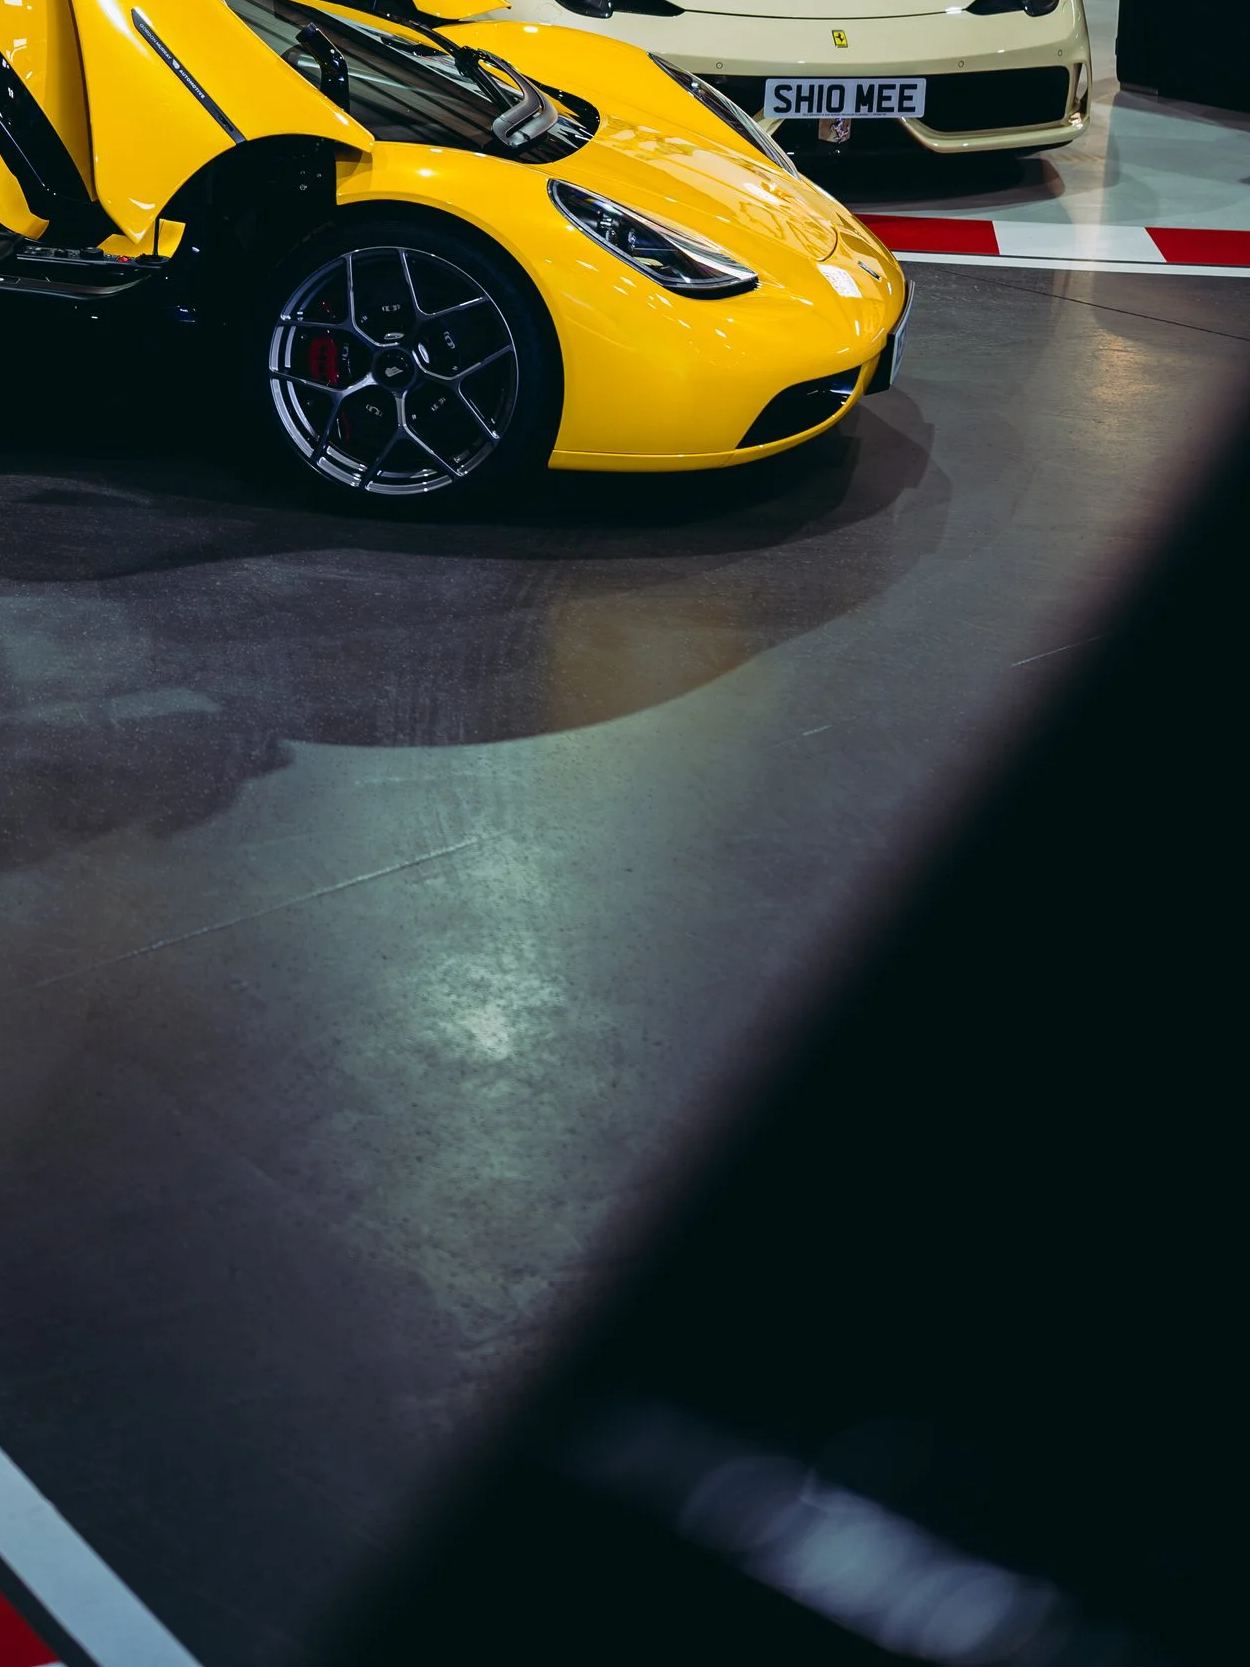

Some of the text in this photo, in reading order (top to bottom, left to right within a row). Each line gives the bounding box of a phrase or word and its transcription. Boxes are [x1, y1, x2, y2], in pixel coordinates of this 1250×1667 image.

[139, 23, 206, 99] GORDON MURRAY AUTOMOTIVE
[773, 83, 918, 113] SH10 MEE
